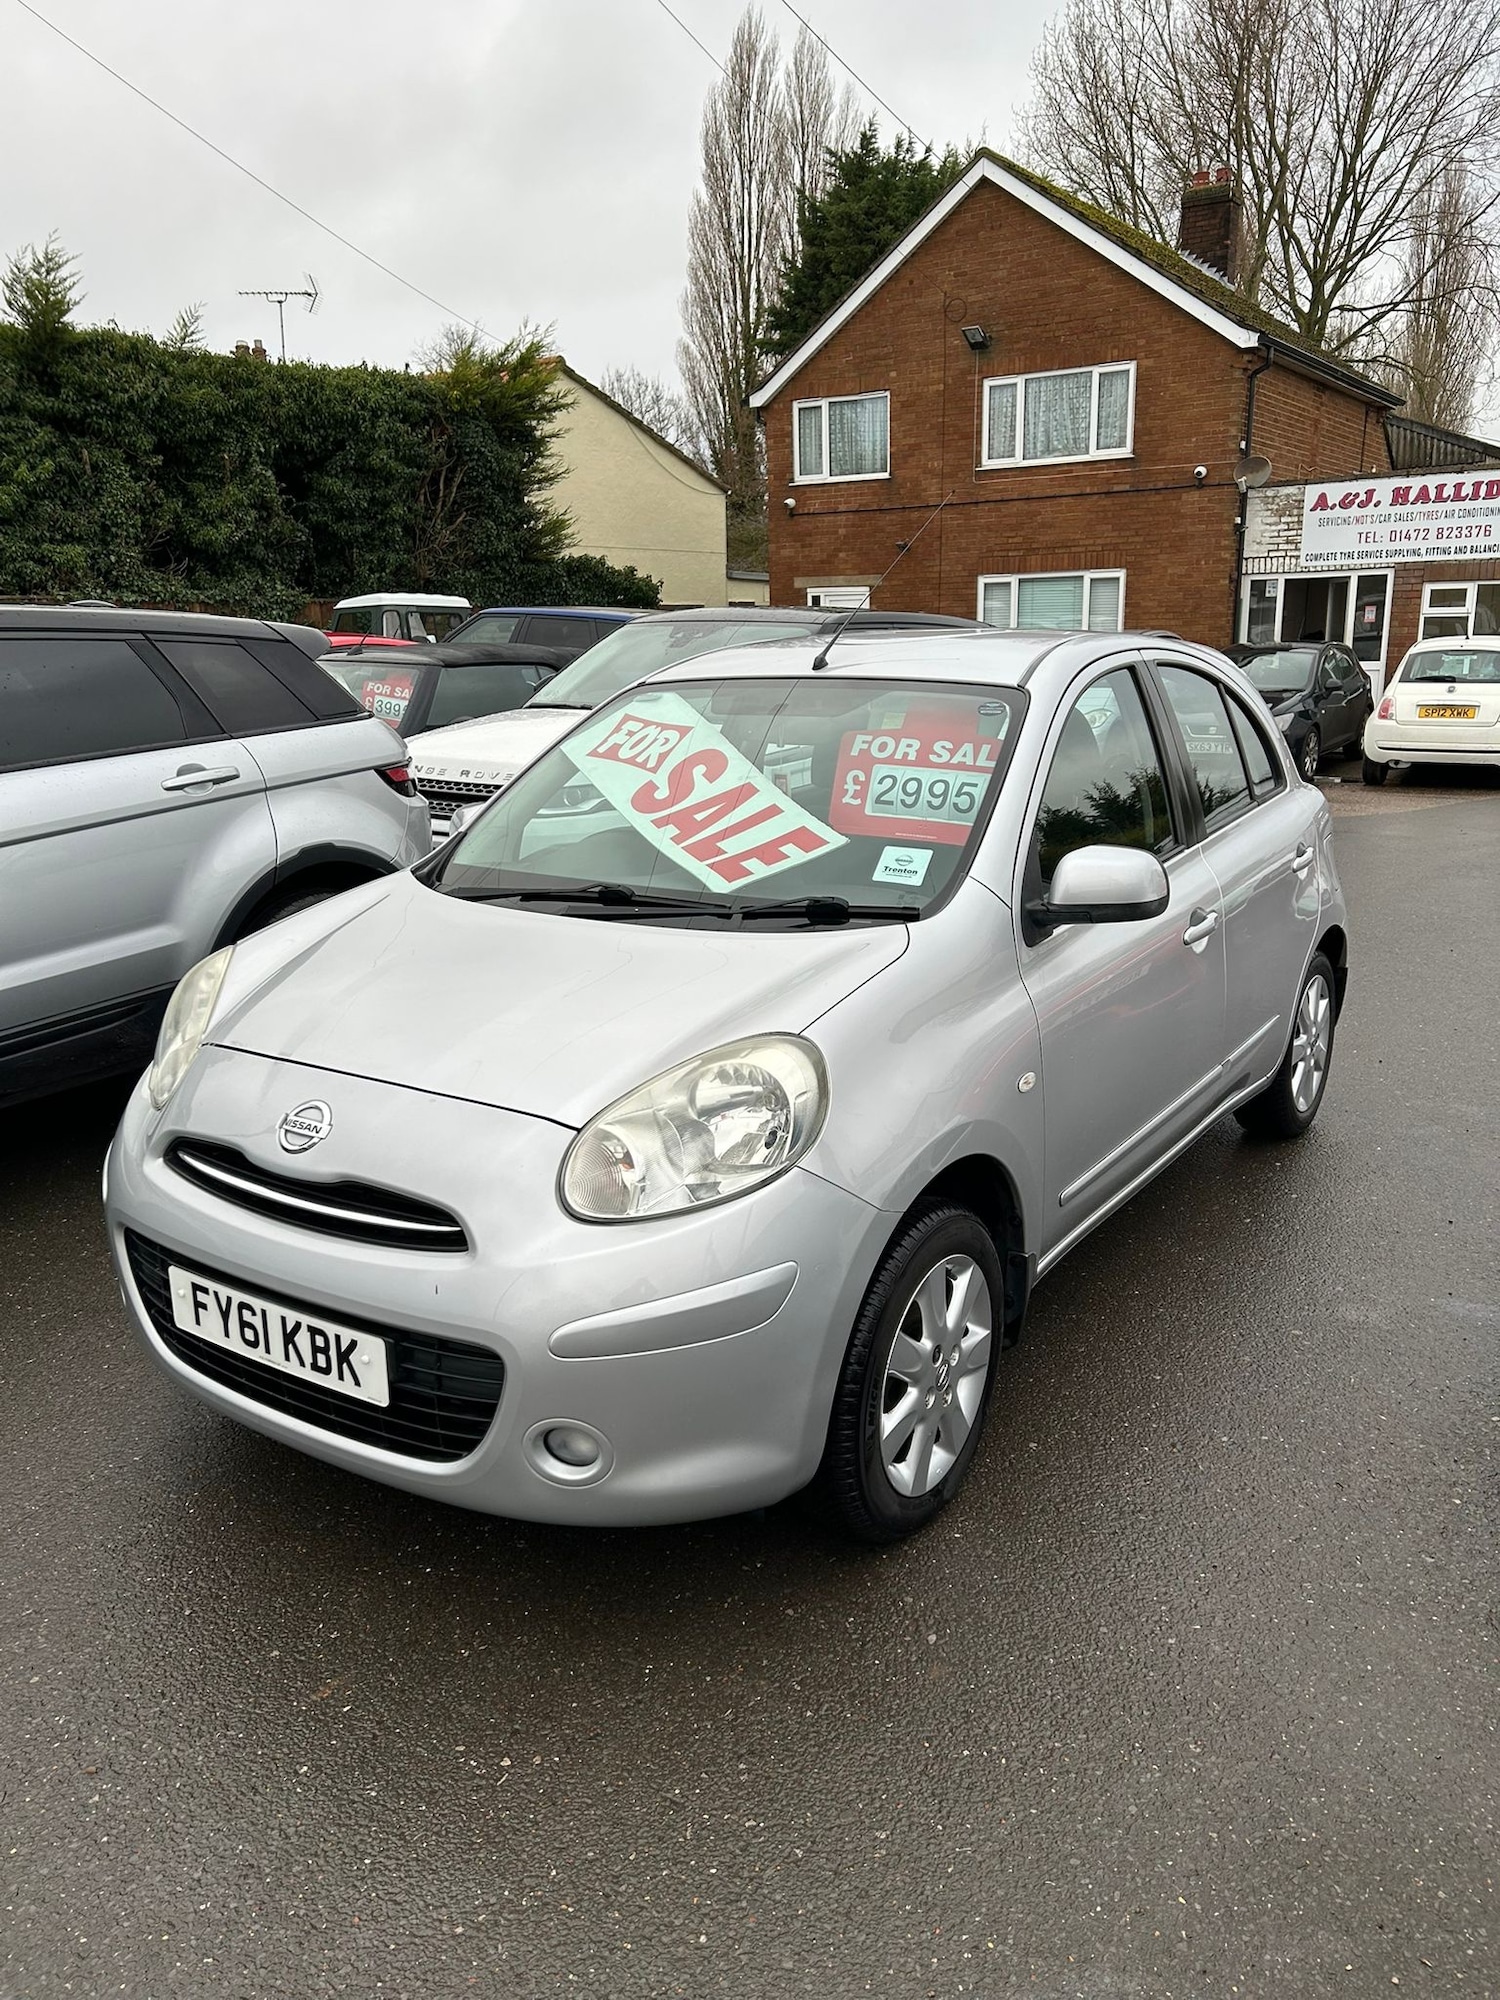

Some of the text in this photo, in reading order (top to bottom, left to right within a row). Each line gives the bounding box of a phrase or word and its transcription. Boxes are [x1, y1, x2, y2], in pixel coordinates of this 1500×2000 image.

[1357, 524, 1492, 544] TEL: 01472 823376
[1305, 552, 1338, 562] COMPLETE
[1340, 551, 1355, 561] TYRE
[1356, 549, 1384, 560] SERVICE
[1385, 547, 1424, 558] SUPPLYING,
[1425, 546, 1452, 556] FITTING
[1453, 544, 1468, 555] AND
[366, 681, 392, 696] FOR
[1424, 708, 1470, 718] SP12 XWK
[850, 734, 921, 761] FOR
[841, 769, 979, 814] £ 2995
[596, 720, 830, 884] FOR SALE
[883, 865, 918, 875] Trenton
[285, 1118, 323, 1134] NISSAN
[190, 1281, 362, 1388] FY61 KBK
